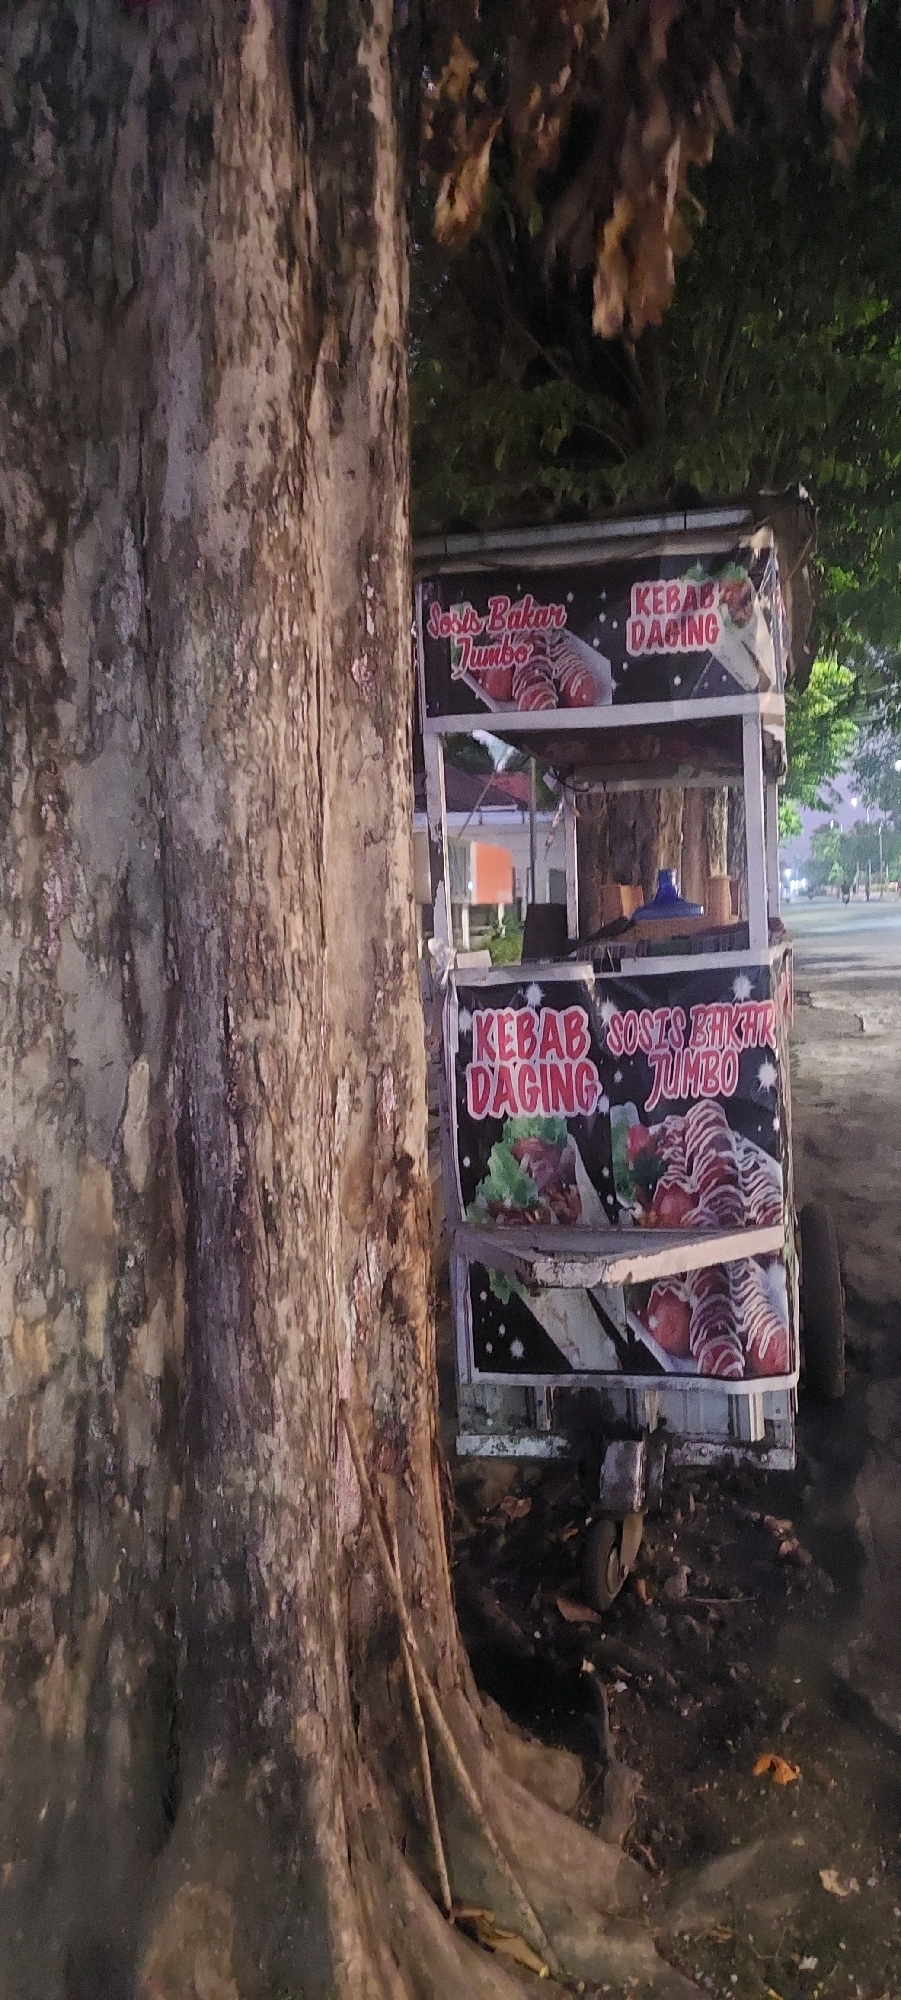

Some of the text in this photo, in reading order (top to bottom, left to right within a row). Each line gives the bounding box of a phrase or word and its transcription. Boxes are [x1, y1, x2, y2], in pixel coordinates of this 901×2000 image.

[428, 596, 566, 637] Sosis Bakar
[634, 582, 715, 616] KEBAB
[630, 613, 720, 650] DAGING
[455, 636, 533, 676] Jumbo
[474, 1009, 588, 1062] KEBAB
[608, 1002, 776, 1054] SOSIS BAKAR
[470, 1062, 598, 1115] DAGING
[645, 1049, 738, 1111] JUMBO
